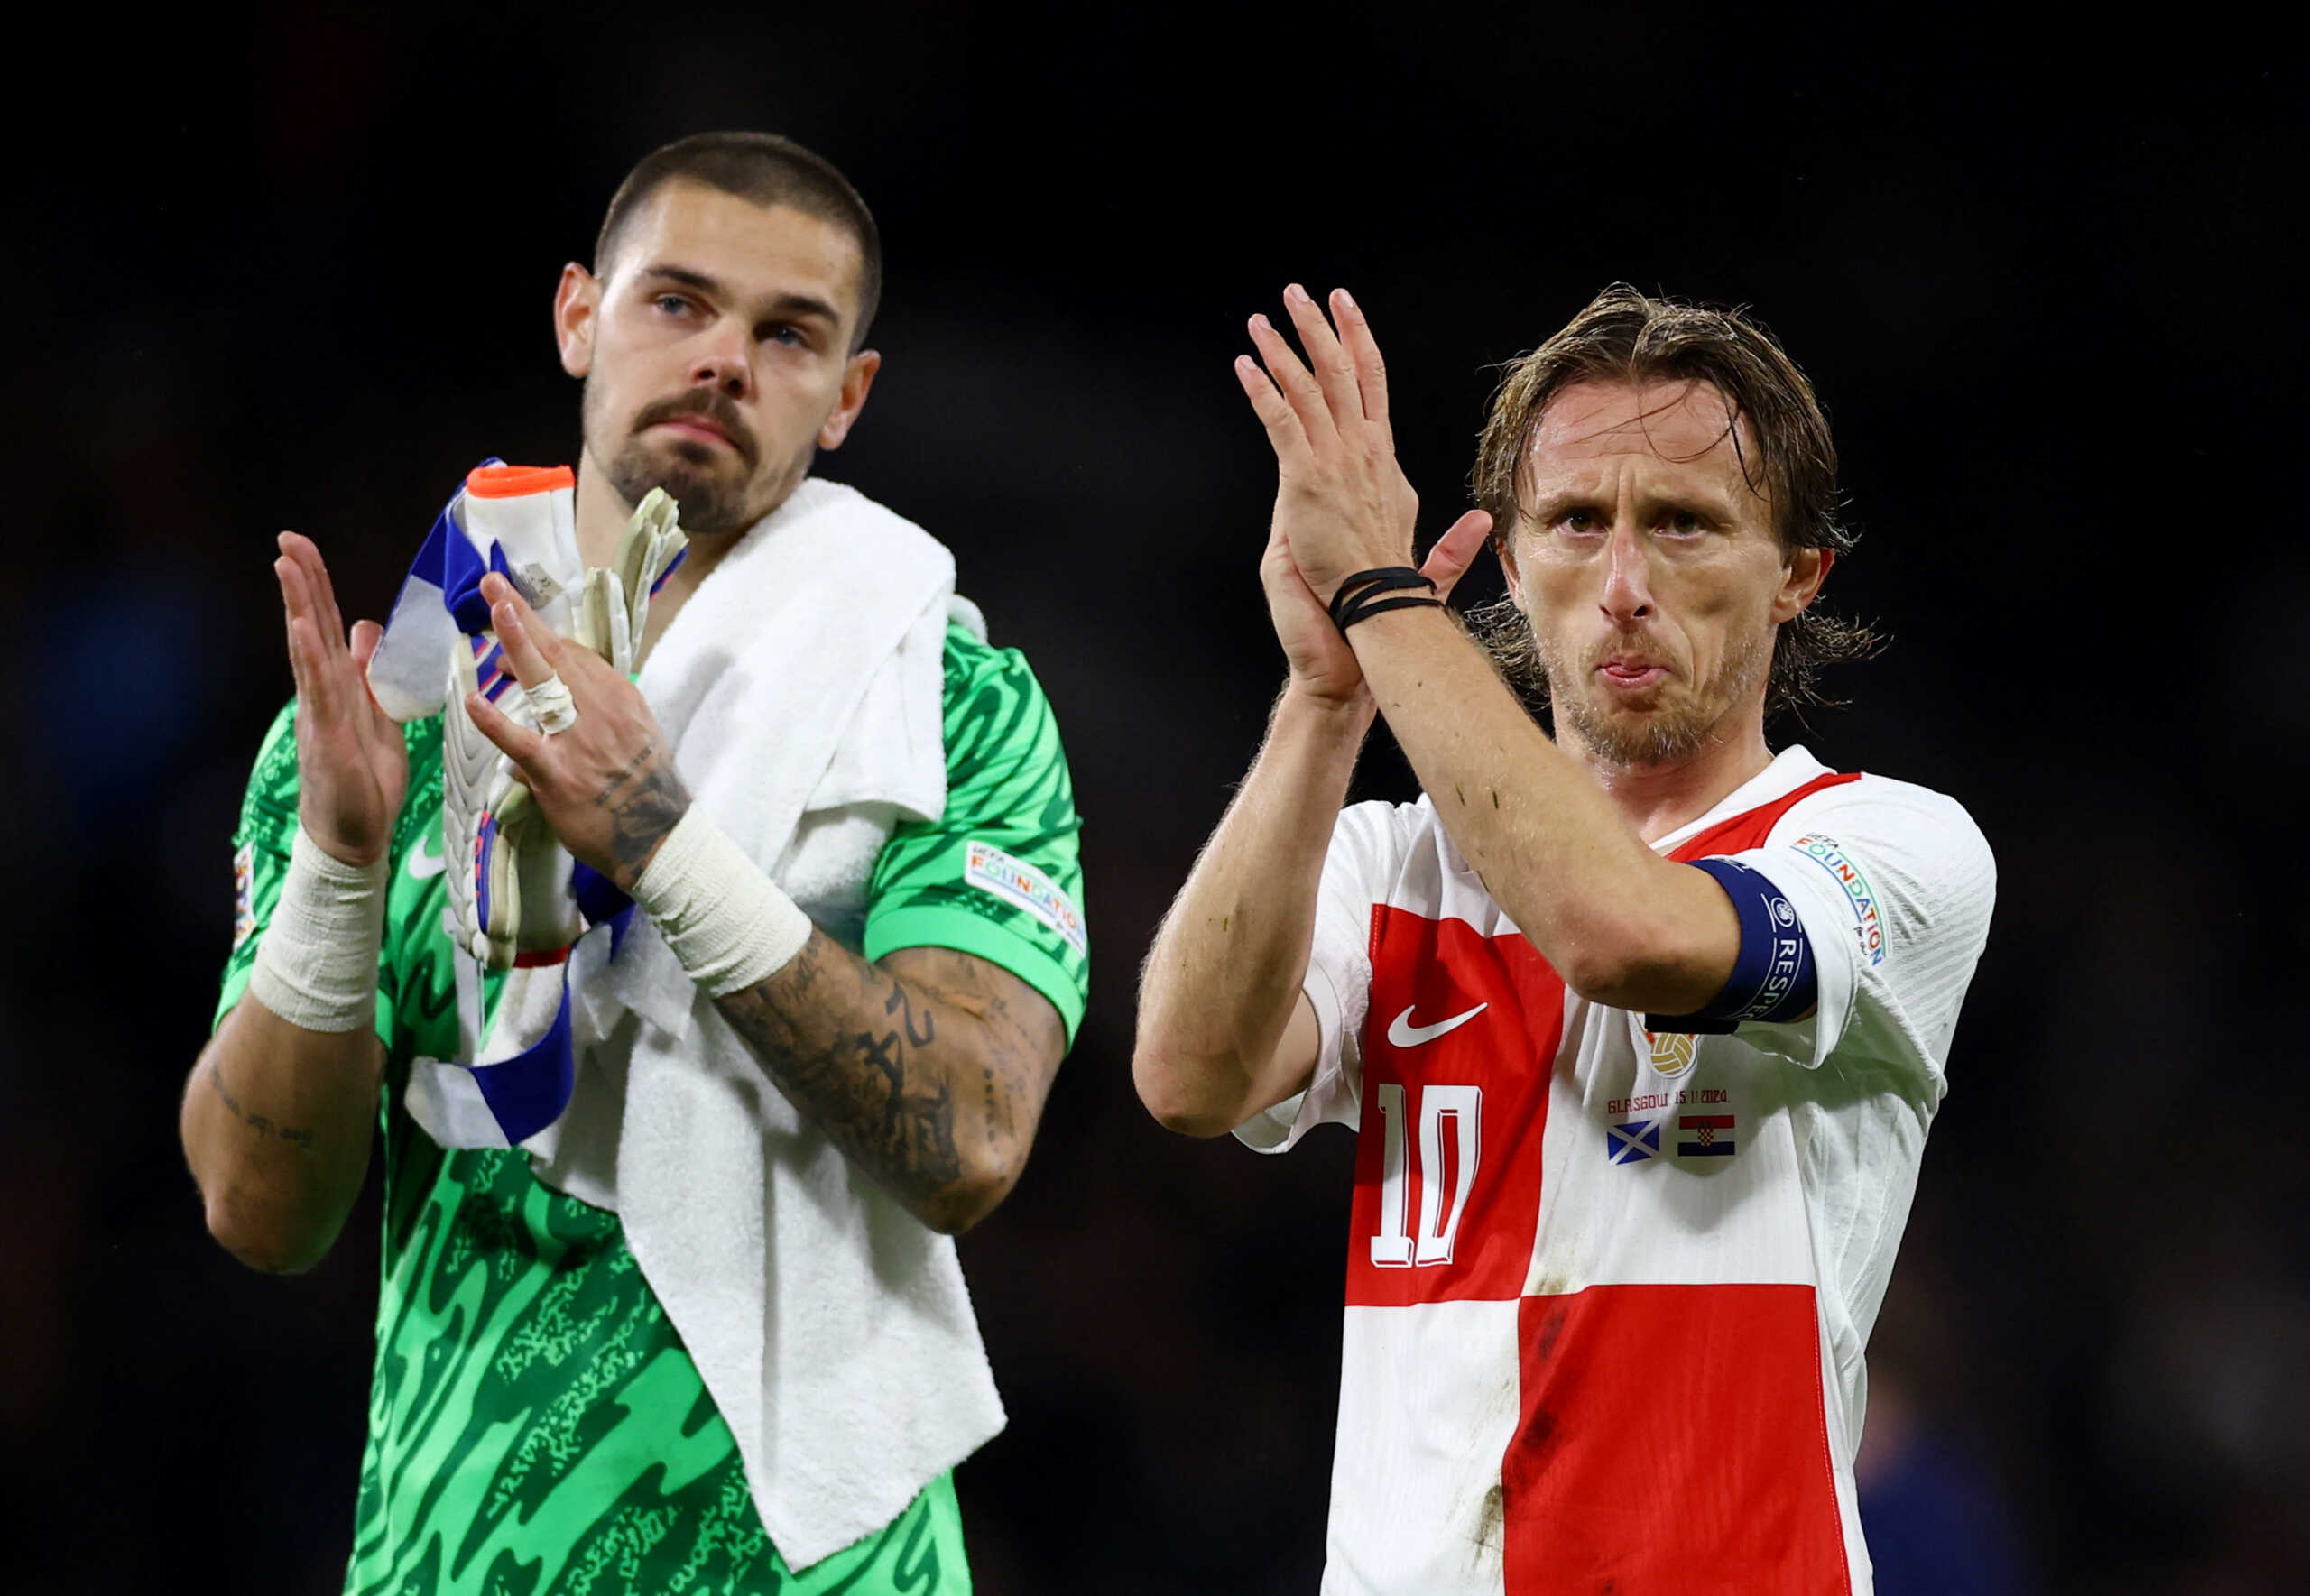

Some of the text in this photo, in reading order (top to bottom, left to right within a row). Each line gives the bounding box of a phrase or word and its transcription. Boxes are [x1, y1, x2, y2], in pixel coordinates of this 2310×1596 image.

[1806, 832, 1839, 849] UEFA
[1793, 837, 1883, 967] FOUNDATION
[1608, 1093, 1668, 1114] GLASGOW
[1371, 1083, 1483, 1268] 10
